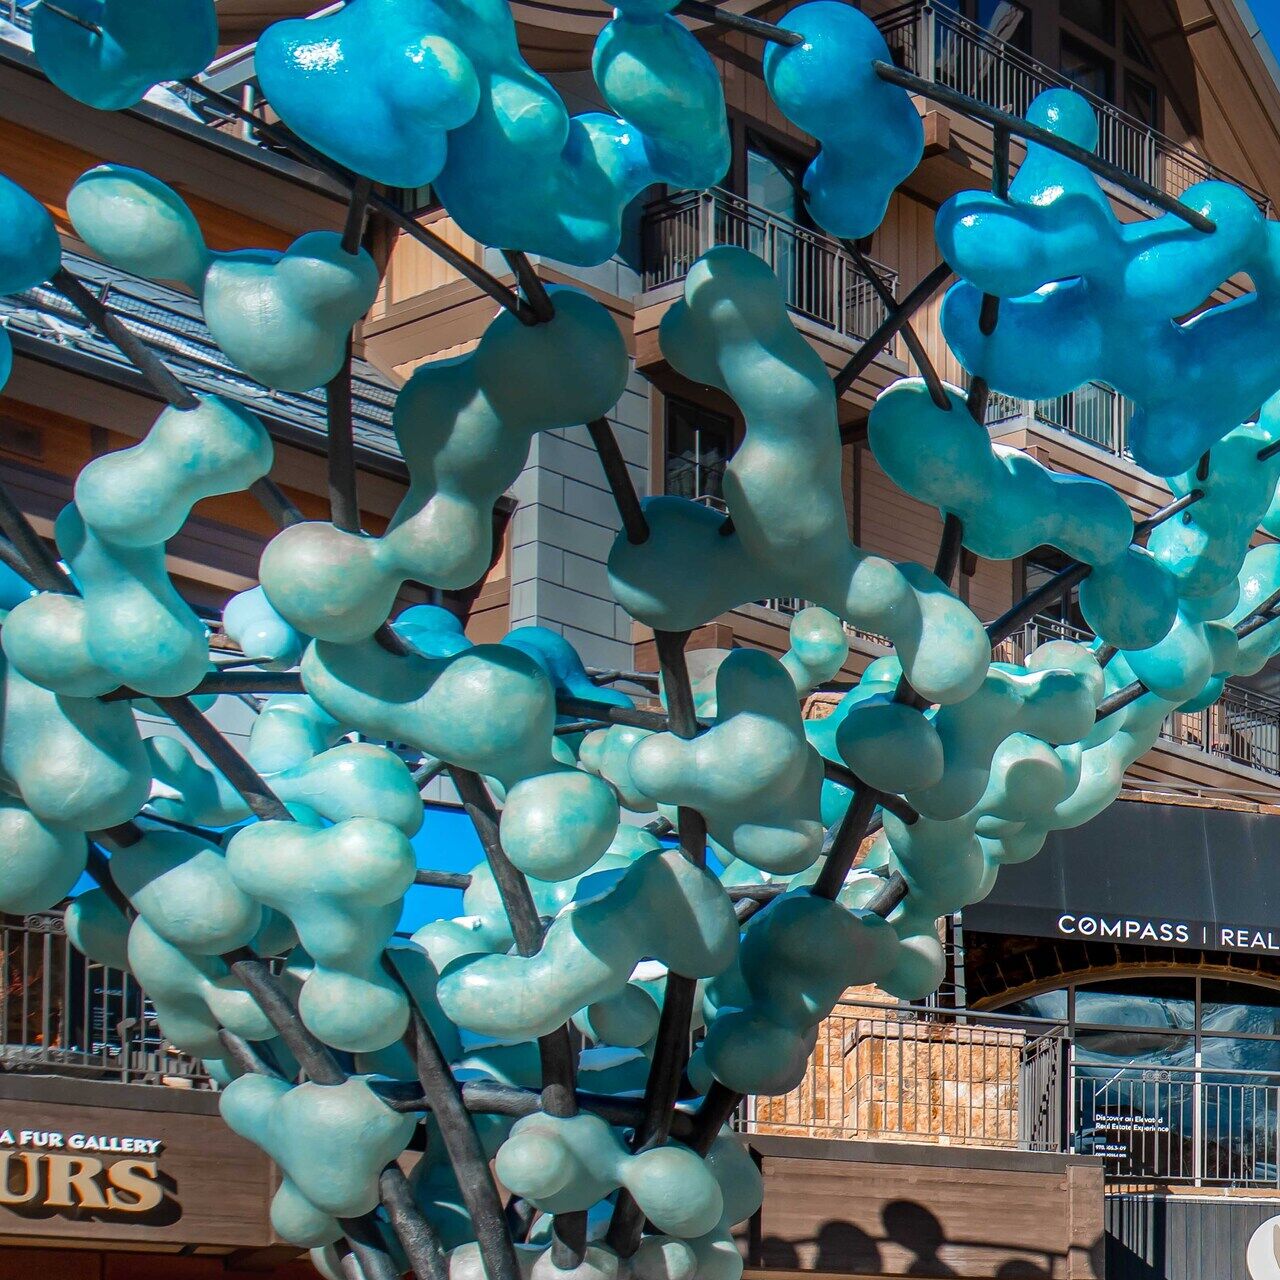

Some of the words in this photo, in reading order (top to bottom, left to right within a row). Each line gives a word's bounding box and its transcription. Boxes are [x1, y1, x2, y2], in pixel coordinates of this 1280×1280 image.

[1058, 914, 1190, 943] COMPASS
[1221, 928, 1280, 950] REAL
[20, 1130, 65, 1148] FUR
[68, 1134, 162, 1154] GALLERY
